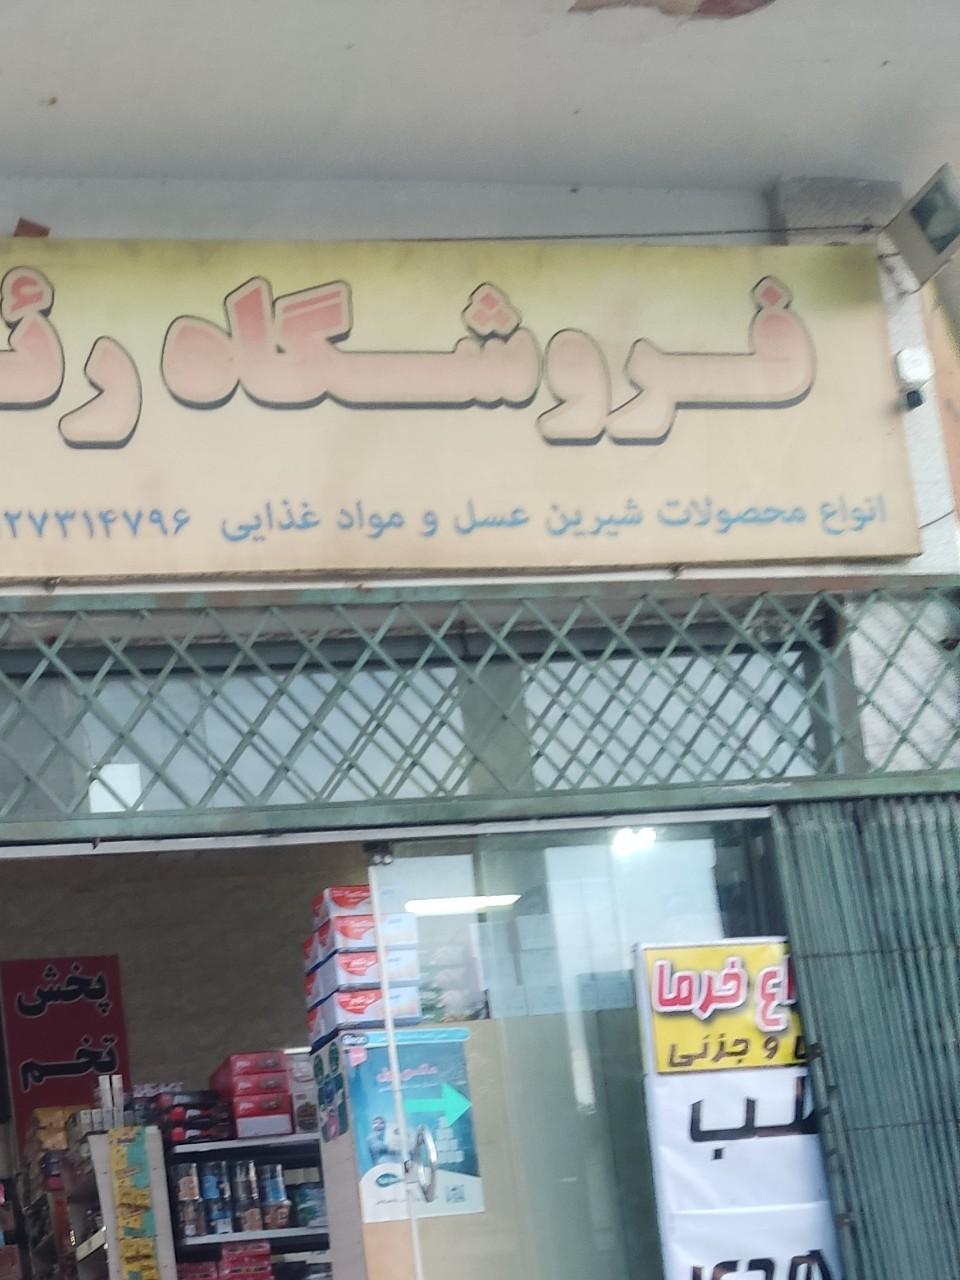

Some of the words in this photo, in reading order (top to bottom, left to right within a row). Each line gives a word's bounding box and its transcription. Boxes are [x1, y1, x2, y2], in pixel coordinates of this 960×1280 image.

[160, 275, 817, 446] فروشگاه
[220, 500, 321, 543] غذایی
[338, 501, 406, 539] مواد
[422, 508, 439, 538] و
[454, 500, 530, 536] عسل
[545, 499, 642, 537] شیرین
[658, 497, 808, 536] محصولات
[819, 495, 887, 536] انواع
[16, 961, 111, 1018] پخش
[653, 956, 750, 1020] خرما
[20, 1034, 118, 1093] تخم
[763, 1034, 779, 1059] و
